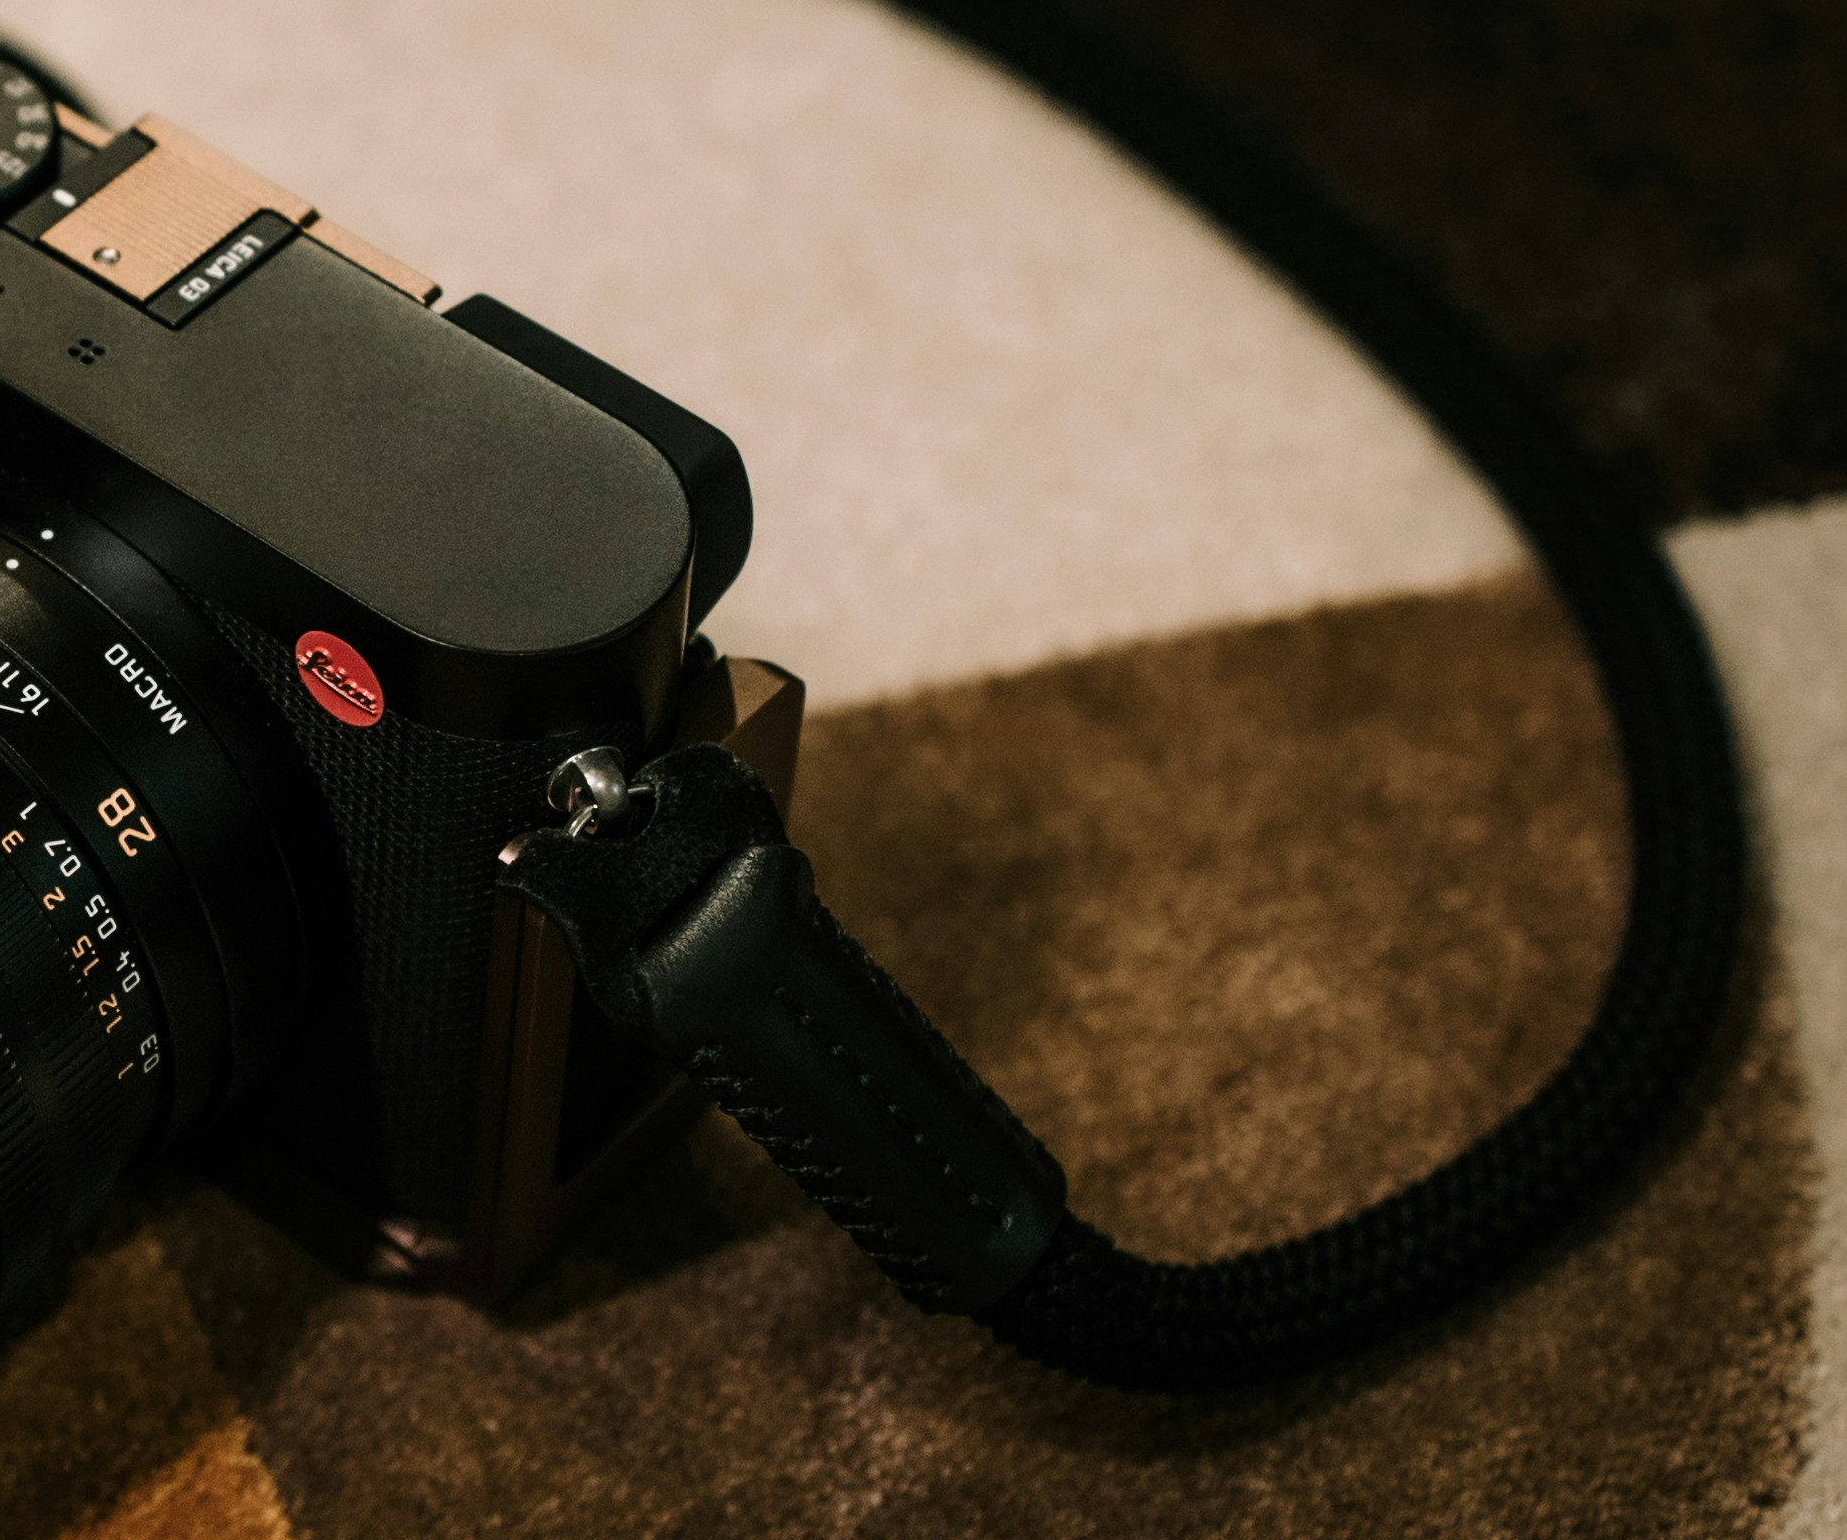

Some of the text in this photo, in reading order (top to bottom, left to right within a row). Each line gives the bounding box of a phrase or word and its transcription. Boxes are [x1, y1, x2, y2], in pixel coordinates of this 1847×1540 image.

[204, 234, 263, 280] LEICA
[20, 684, 49, 716] 16
[104, 643, 187, 735] MACRO
[297, 647, 378, 716] Leica
[19, 801, 37, 820] 1
[97, 787, 156, 857] 28
[1, 829, 25, 853] 3
[44, 839, 81, 877] 0.7
[43, 887, 65, 910] 2
[85, 894, 117, 940] 0.5
[70, 935, 99, 976] 1.5
[116, 950, 141, 993] 0.4
[98, 993, 122, 1034] 1.2
[140, 1034, 159, 1073] 0.3
